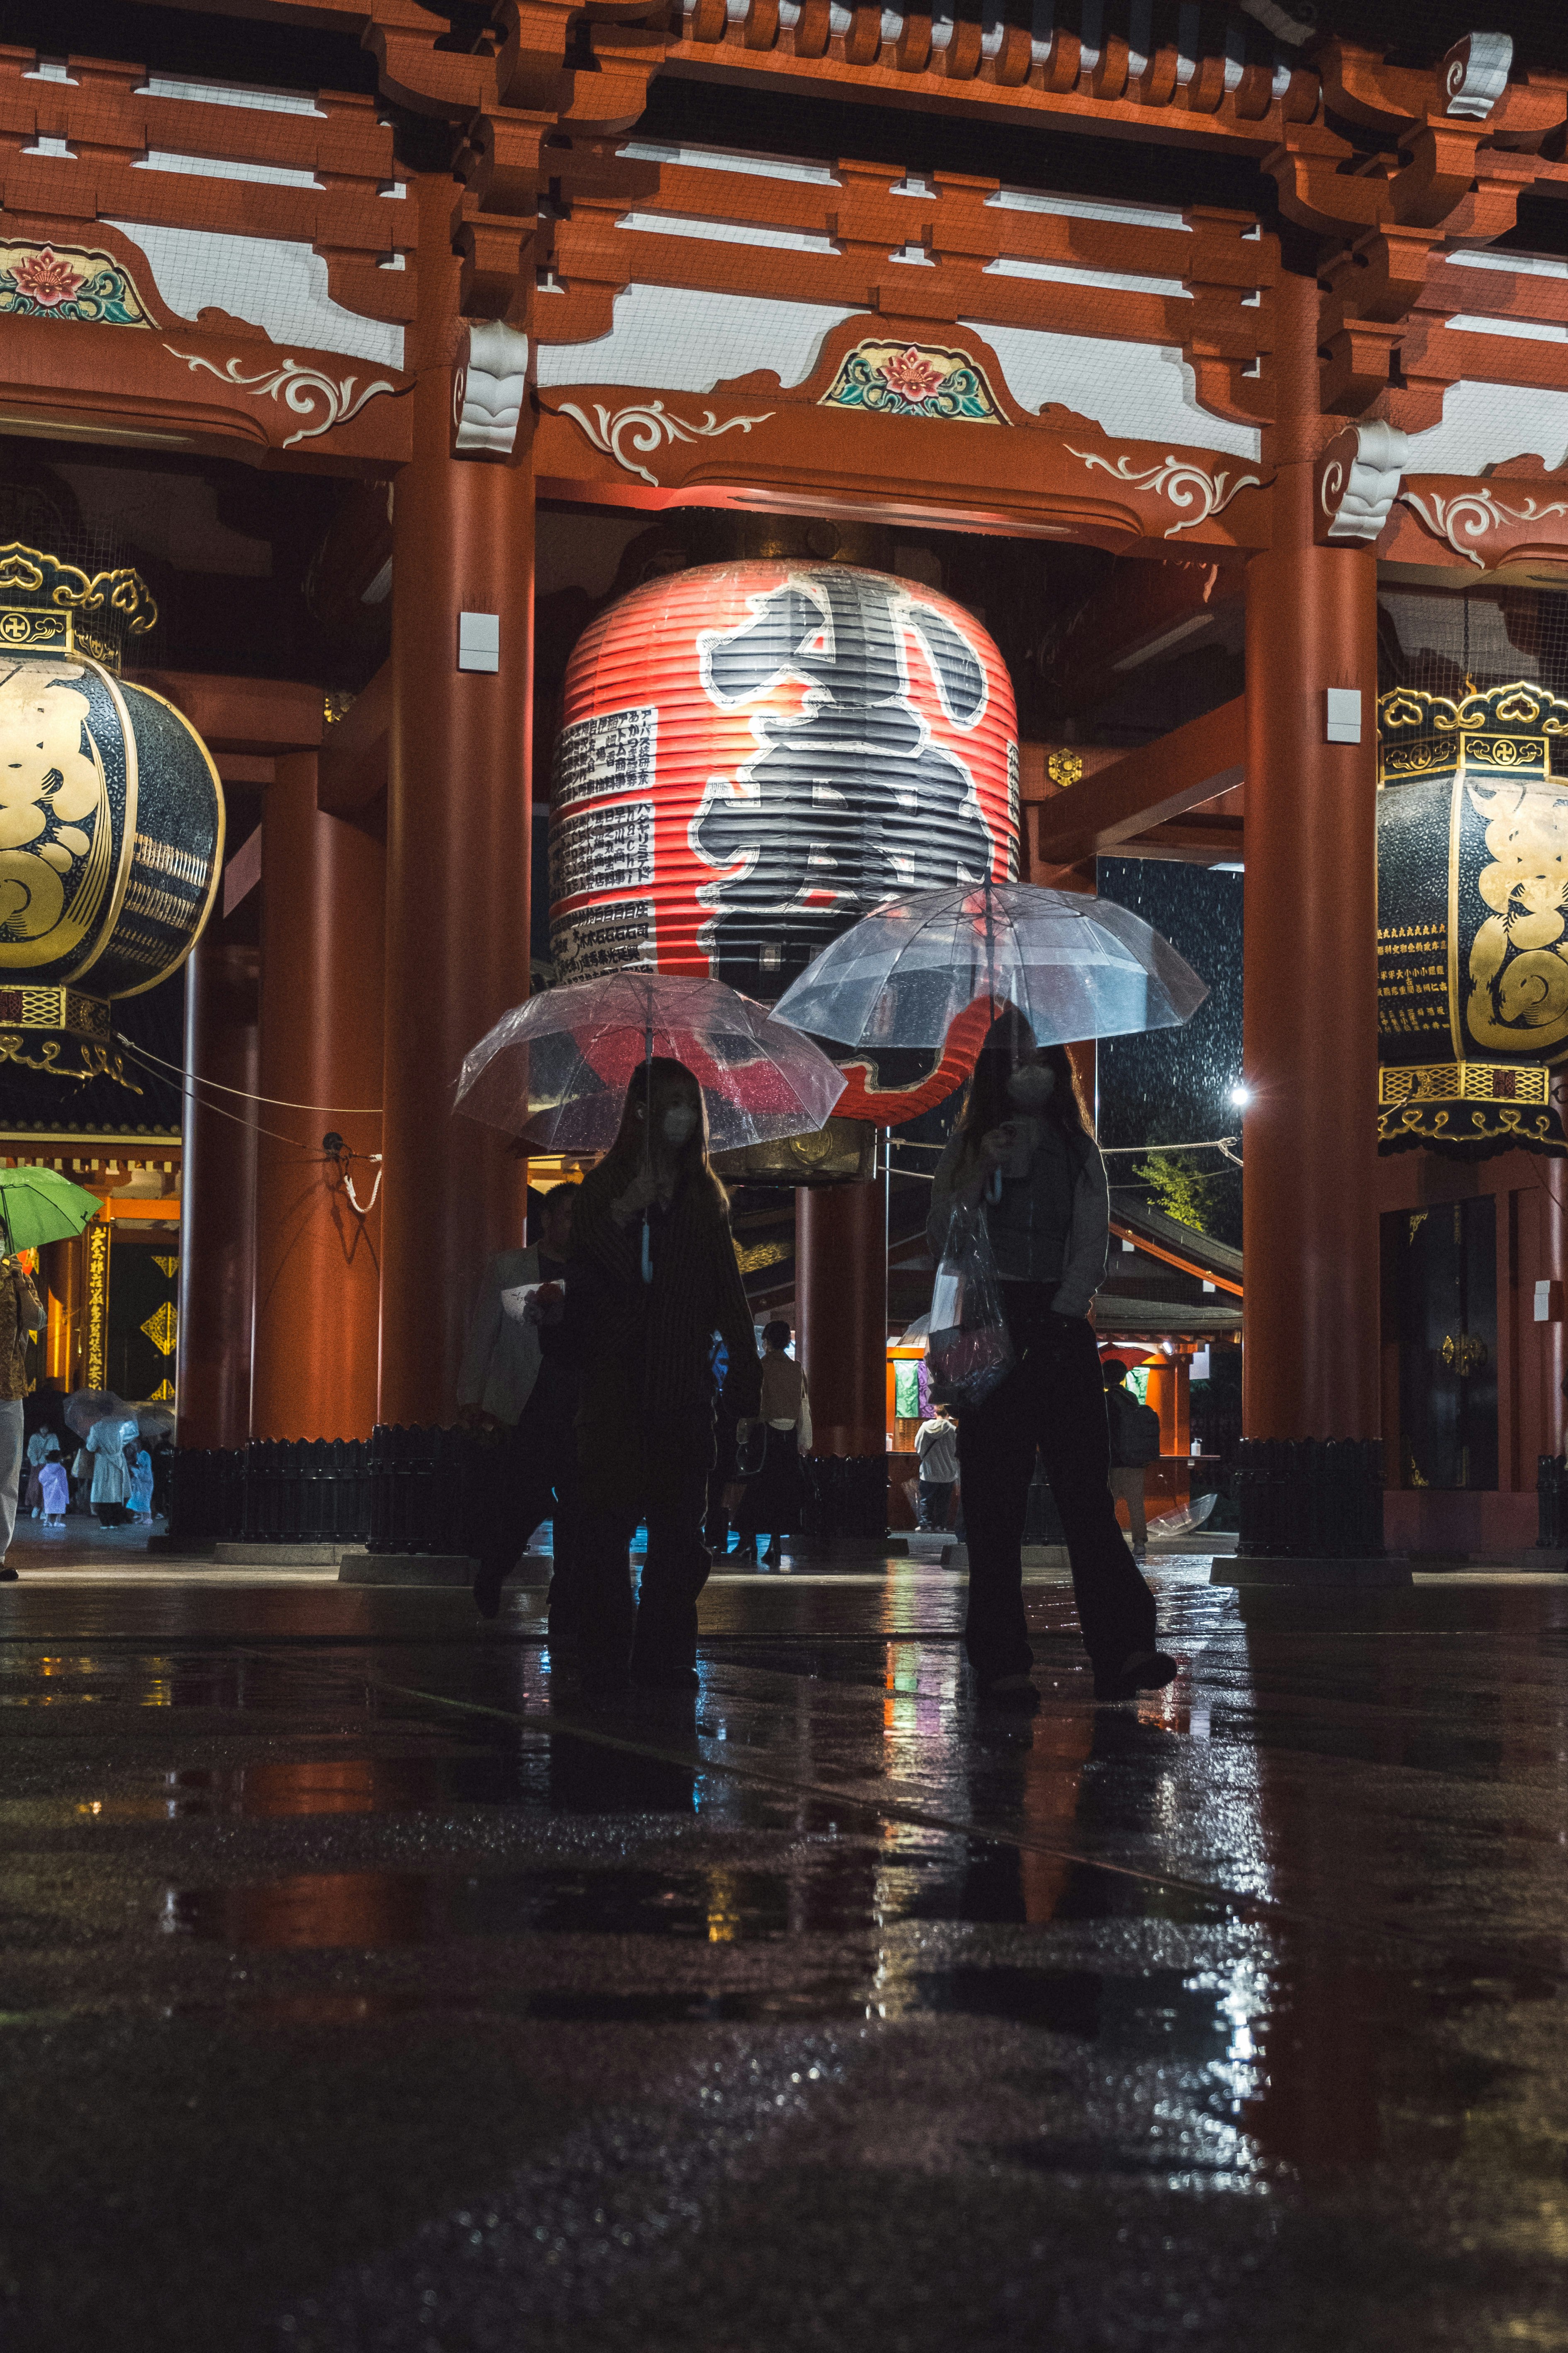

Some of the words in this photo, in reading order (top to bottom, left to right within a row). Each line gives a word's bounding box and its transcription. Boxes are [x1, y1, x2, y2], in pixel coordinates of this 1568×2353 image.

[614, 713, 628, 788] アトム商事
[626, 711, 639, 787] あかつき証券
[614, 807, 625, 884] 早川商事
